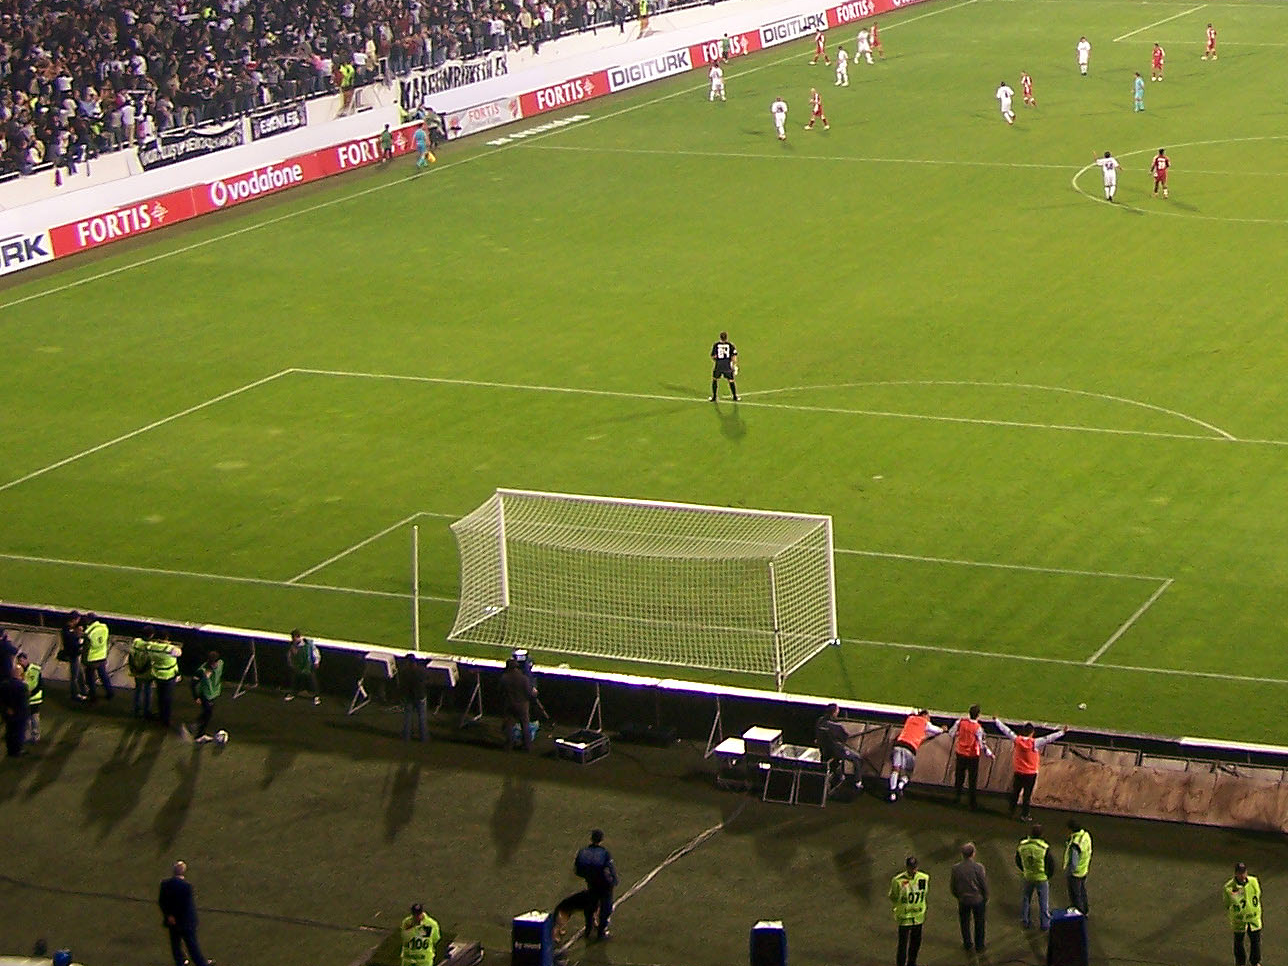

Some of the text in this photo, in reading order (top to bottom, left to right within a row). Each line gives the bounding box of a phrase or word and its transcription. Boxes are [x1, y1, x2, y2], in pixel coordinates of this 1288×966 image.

[836, 0, 869, 24] FORTIS
[611, 51, 689, 87] DIGITURK
[536, 79, 585, 110] FORTIS
[467, 102, 500, 123] FORTIS
[228, 163, 303, 200] vodafone
[76, 203, 152, 247] FORTIS
